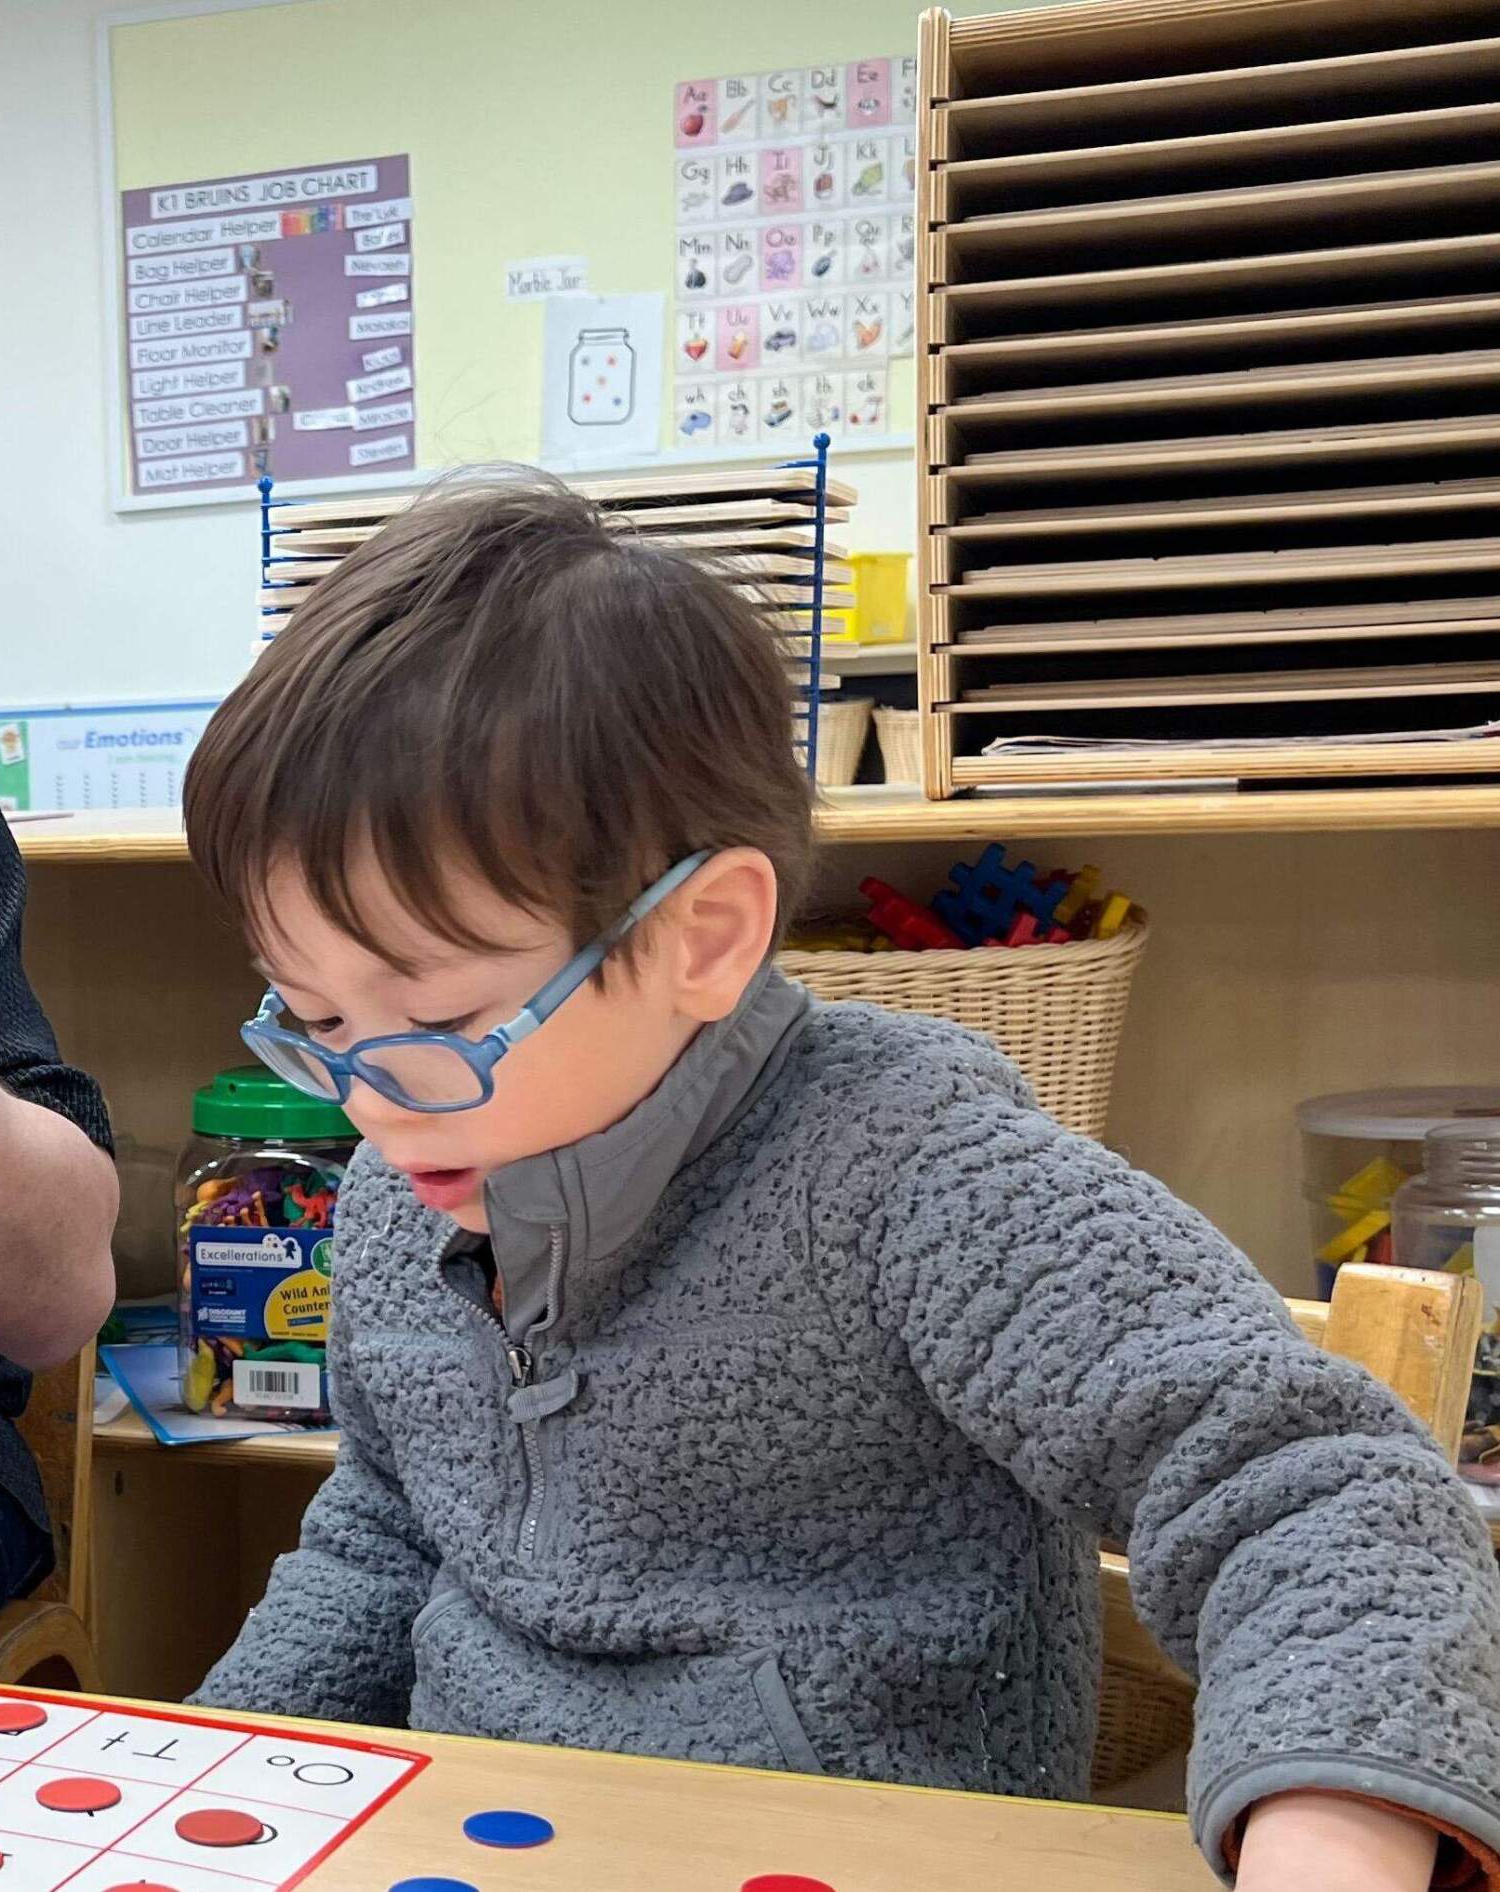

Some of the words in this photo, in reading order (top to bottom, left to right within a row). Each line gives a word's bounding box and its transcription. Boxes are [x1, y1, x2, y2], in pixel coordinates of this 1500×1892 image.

[811, 69, 837, 88] Dd
[857, 64, 878, 83] Ee
[726, 80, 748, 98] Bb
[768, 75, 793, 93] Cc
[813, 144, 833, 170] Jj
[856, 140, 876, 160] Kk
[681, 161, 710, 185] Gg
[725, 155, 749, 175] Hh
[157, 193, 178, 212] K1
[184, 184, 250, 209] BRUINS
[259, 180, 296, 201] JOB
[301, 171, 369, 196] CHART
[132, 228, 214, 249] Calendar
[220, 218, 277, 239] Helper
[725, 232, 749, 251] Nn
[766, 227, 795, 248] Oo
[812, 224, 834, 246] Pp
[680, 238, 711, 256] Mm
[134, 263, 170, 281] Bag
[173, 256, 228, 275] Helper
[508, 271, 550, 296] Marble
[557, 266, 581, 292] Jar
[135, 290, 180, 309] Chair
[184, 283, 239, 303] Helper
[854, 296, 878, 314] Xx
[726, 308, 749, 327] Uu
[769, 303, 792, 321] Vv
[807, 300, 838, 318] Ww
[136, 319, 171, 335] Line
[173, 311, 235, 331] Leader
[686, 312, 705, 329] Tt
[137, 347, 179, 363] Floor
[182, 339, 246, 358] Monitor
[139, 375, 179, 396] Light
[182, 369, 238, 389] Helper
[728, 384, 747, 401] ch
[685, 386, 705, 404] wh
[140, 406, 184, 422] Table
[188, 398, 257, 418] Cleaner
[142, 436, 183, 453] Door
[186, 429, 241, 449] Helper
[145, 467, 180, 482] Mat
[181, 459, 238, 478] Helper
[84, 731, 183, 749] Emotions
[201, 1249, 284, 1262] Excellerations
[281, 1285, 307, 1301] Wild
[99, 1731, 179, 1761] Tt
[265, 1755, 354, 1786] Oo
